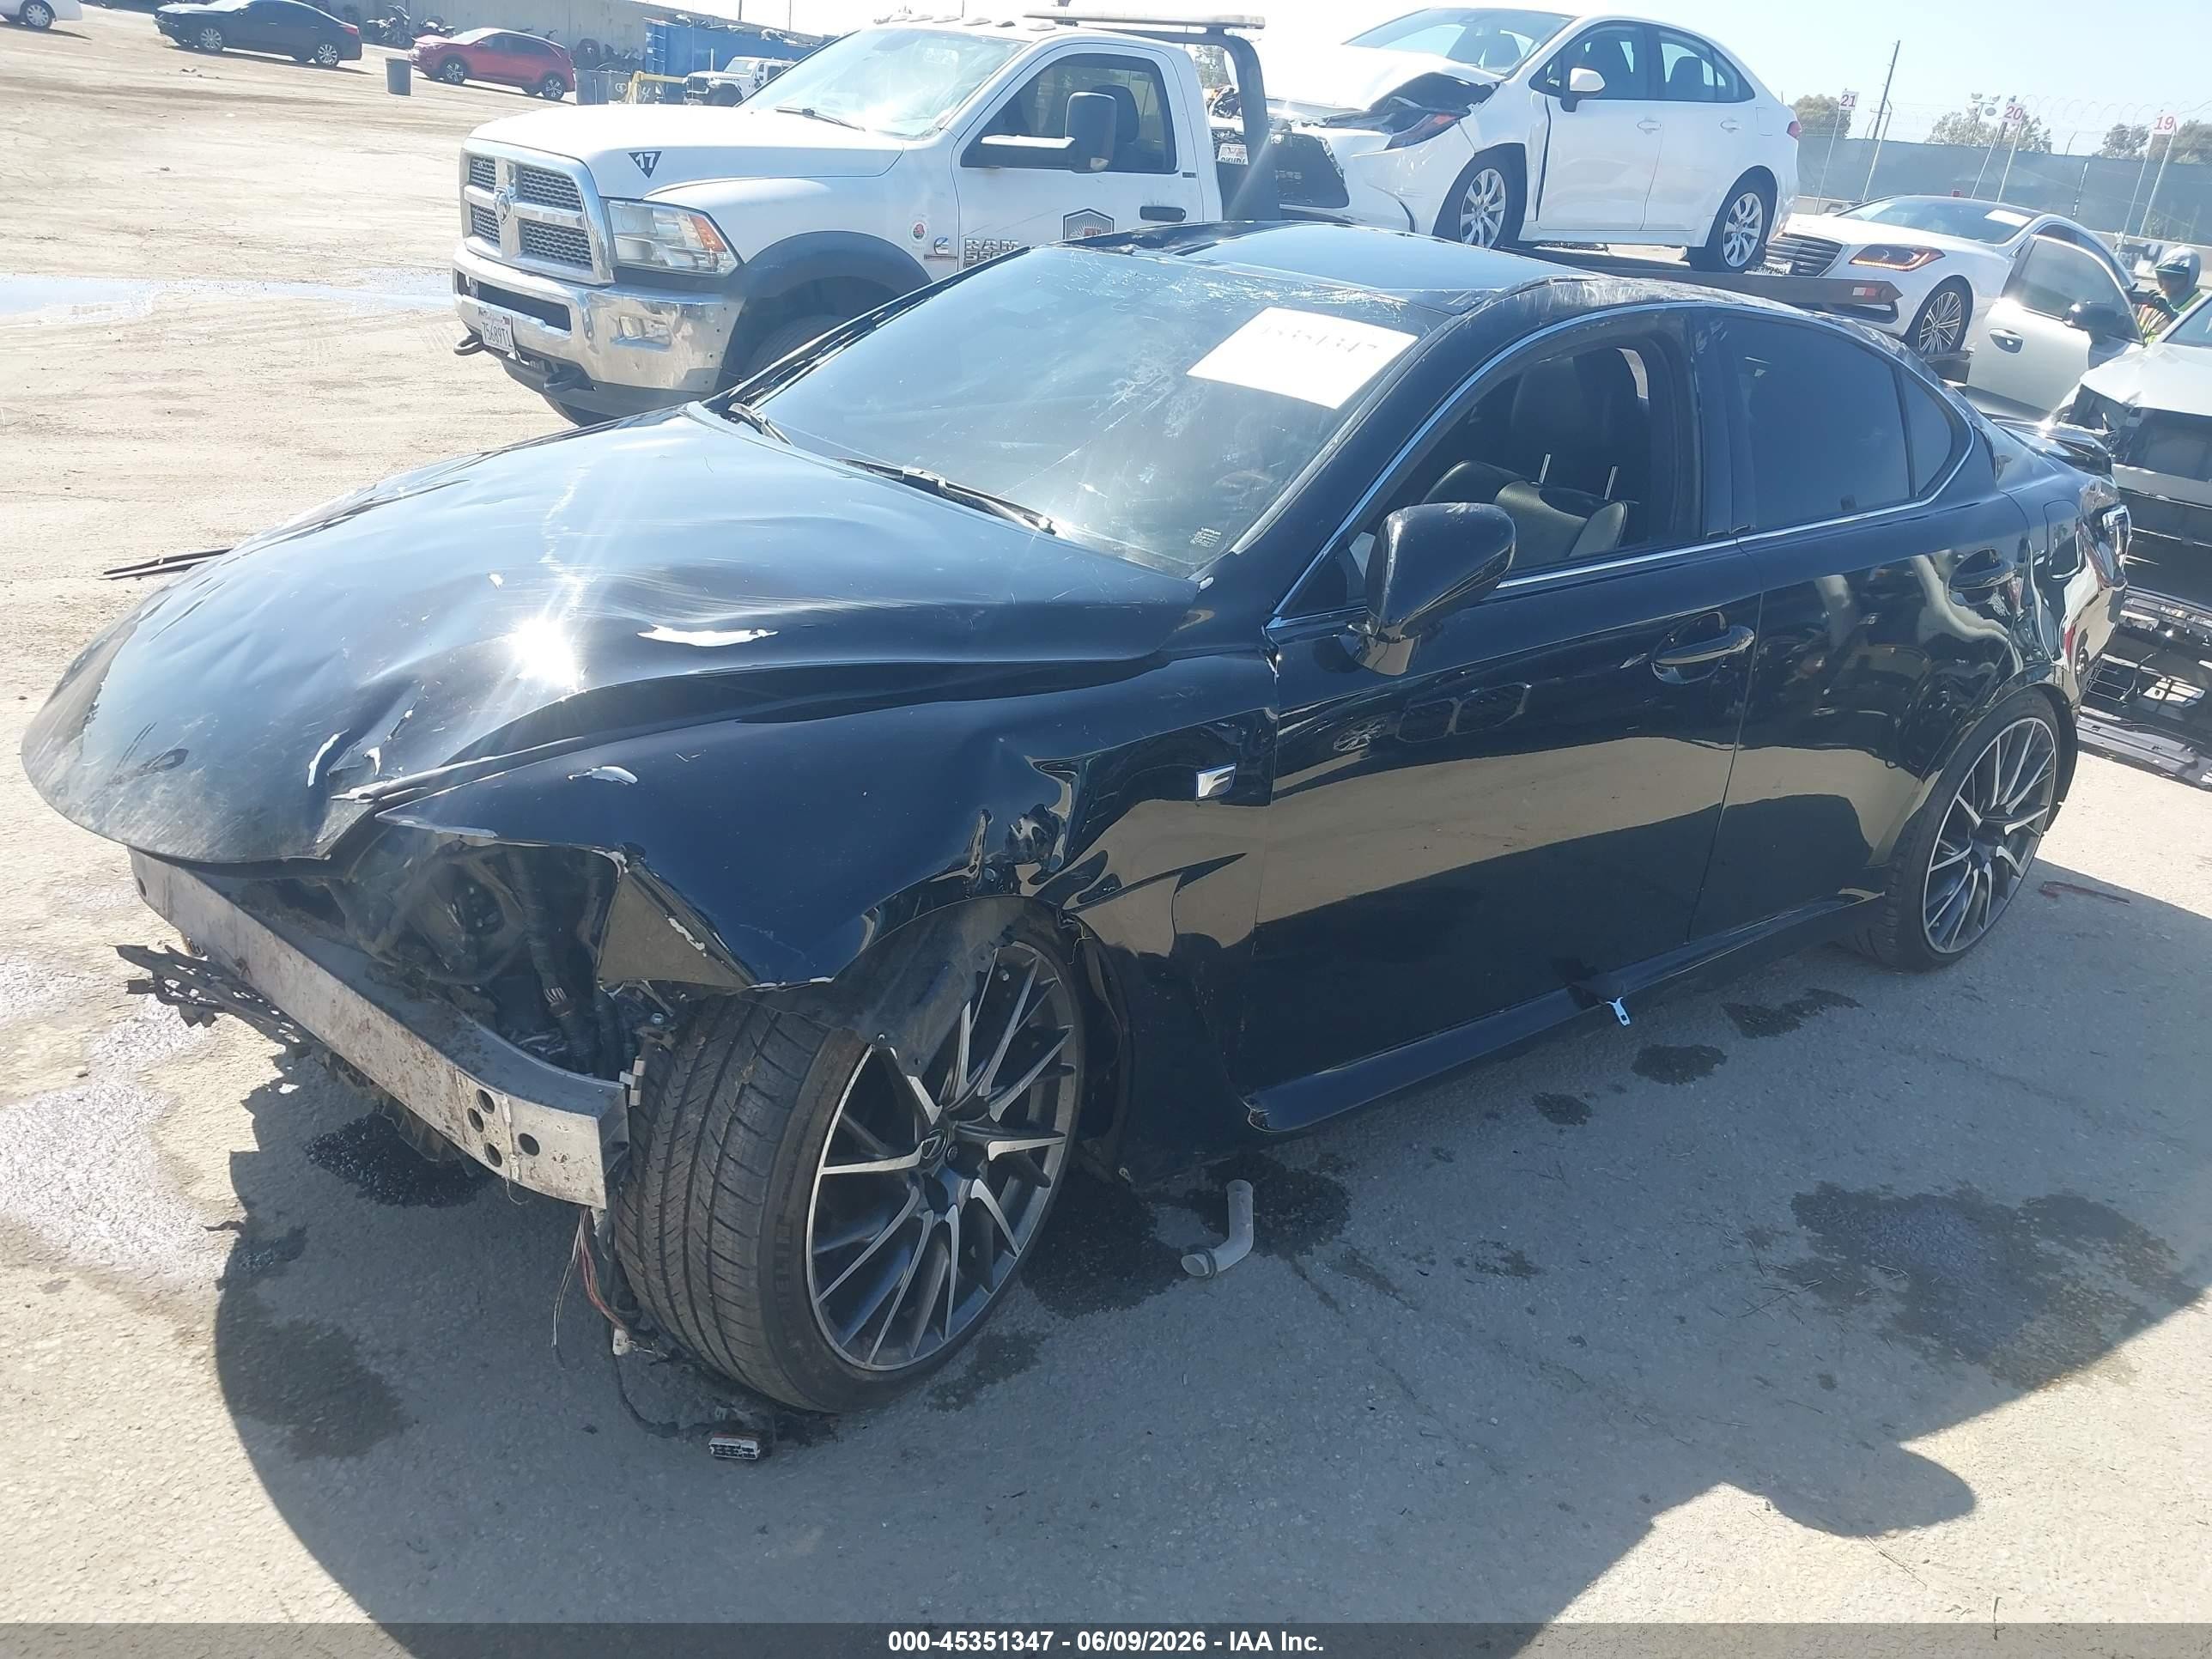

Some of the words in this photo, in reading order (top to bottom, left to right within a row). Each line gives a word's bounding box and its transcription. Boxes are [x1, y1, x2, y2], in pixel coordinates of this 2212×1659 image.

[1840, 94, 1856, 107] 21
[2004, 106, 2024, 120] 20
[2154, 116, 2174, 131] 19
[635, 153, 656, 169] 17
[964, 238, 1018, 252] RAM
